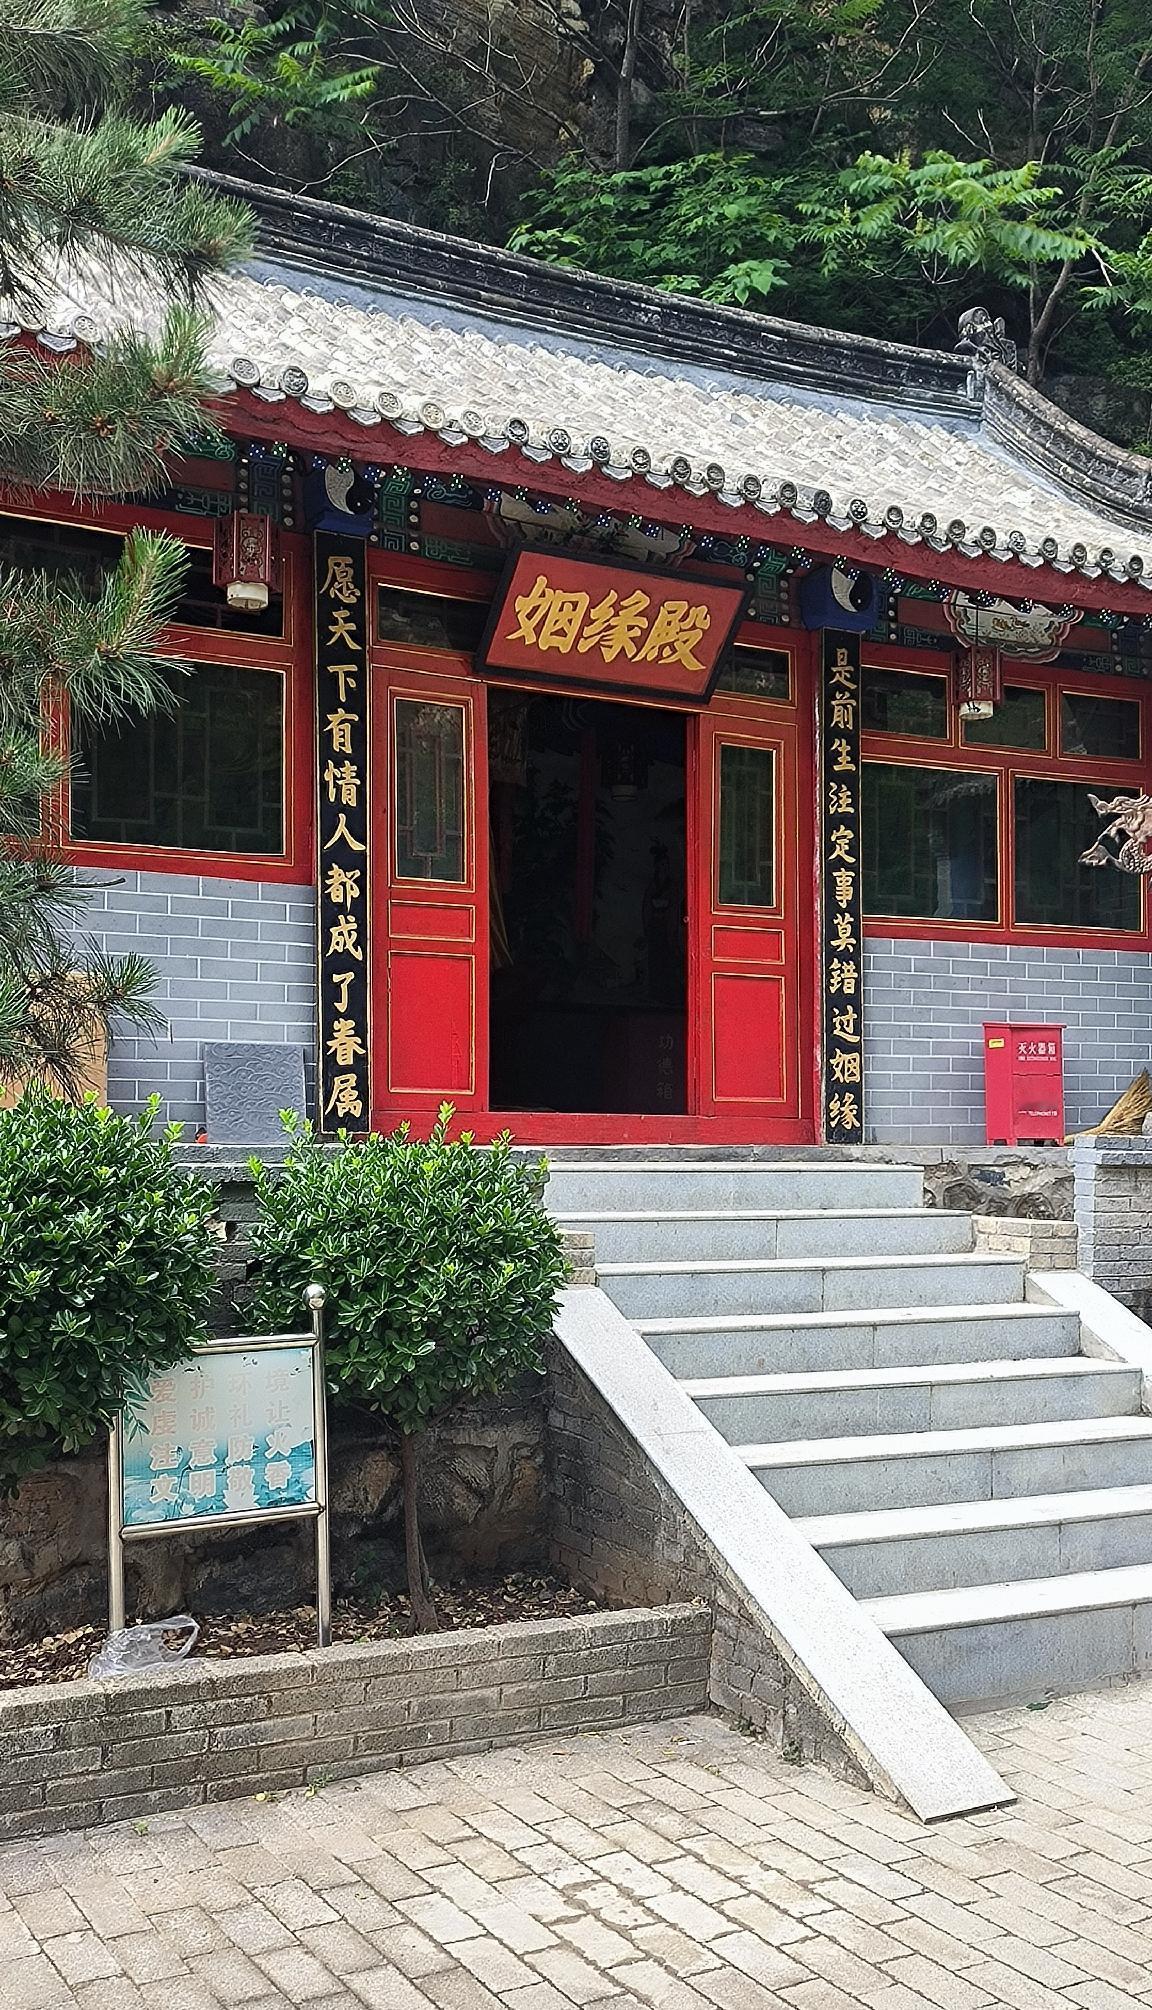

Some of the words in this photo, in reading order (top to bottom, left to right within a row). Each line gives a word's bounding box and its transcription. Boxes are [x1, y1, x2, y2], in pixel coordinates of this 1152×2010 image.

[505, 574, 711, 671] 姻缘殿
[319, 556, 366, 1118] 愿天下有情人都成了眷属
[829, 648, 861, 1130] 是前生注定事莫错过姻缘
[1017, 1042, 1056, 1055] 灭火器箱
[150, 1368, 291, 1403] 爱护环境
[150, 1399, 292, 1436] 虔诚礼让
[149, 1429, 292, 1470] 注意防火
[149, 1460, 292, 1503] 文明敬香
